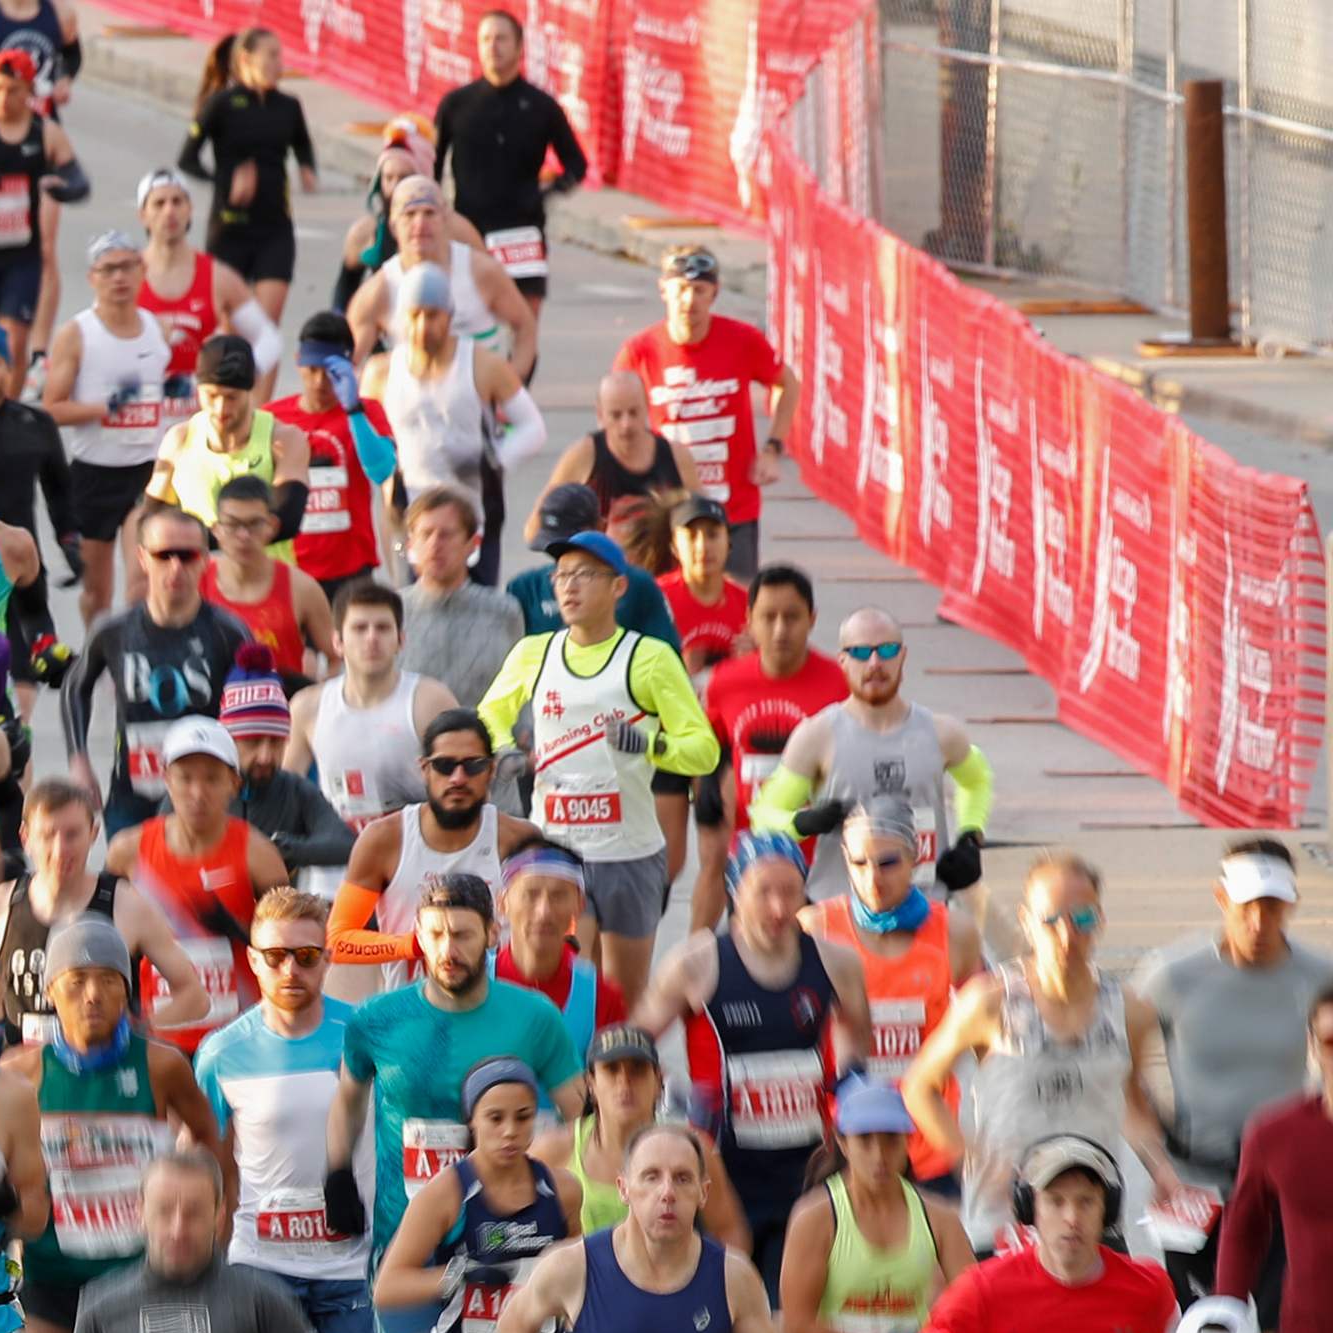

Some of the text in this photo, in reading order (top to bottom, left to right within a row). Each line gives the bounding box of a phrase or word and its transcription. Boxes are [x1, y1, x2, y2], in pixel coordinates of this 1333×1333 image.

[549, 799, 607, 822] A 9045
[270, 1214, 336, 1239] A 801
